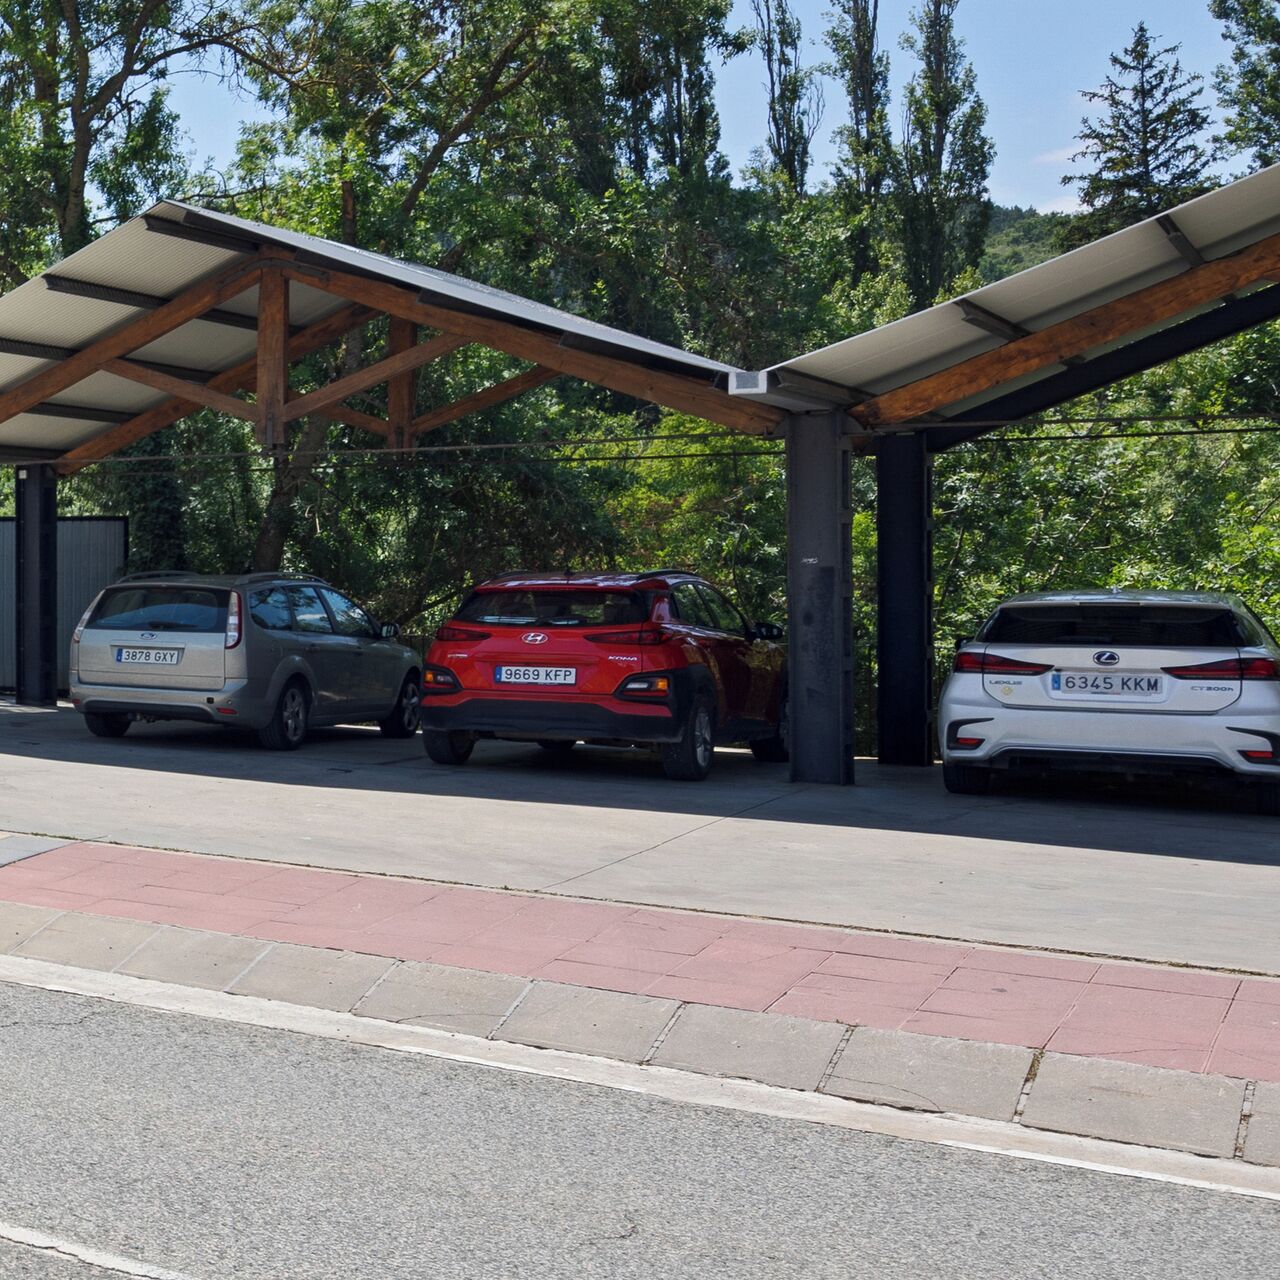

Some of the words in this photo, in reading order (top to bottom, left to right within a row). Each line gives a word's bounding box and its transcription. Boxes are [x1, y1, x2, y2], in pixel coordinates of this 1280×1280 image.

[124, 650, 151, 661] 3878
[154, 651, 176, 662] GXY
[504, 668, 540, 680] 9669
[545, 669, 572, 681] KFP
[1065, 676, 1114, 690] 6345
[1121, 677, 1159, 692] KKM
